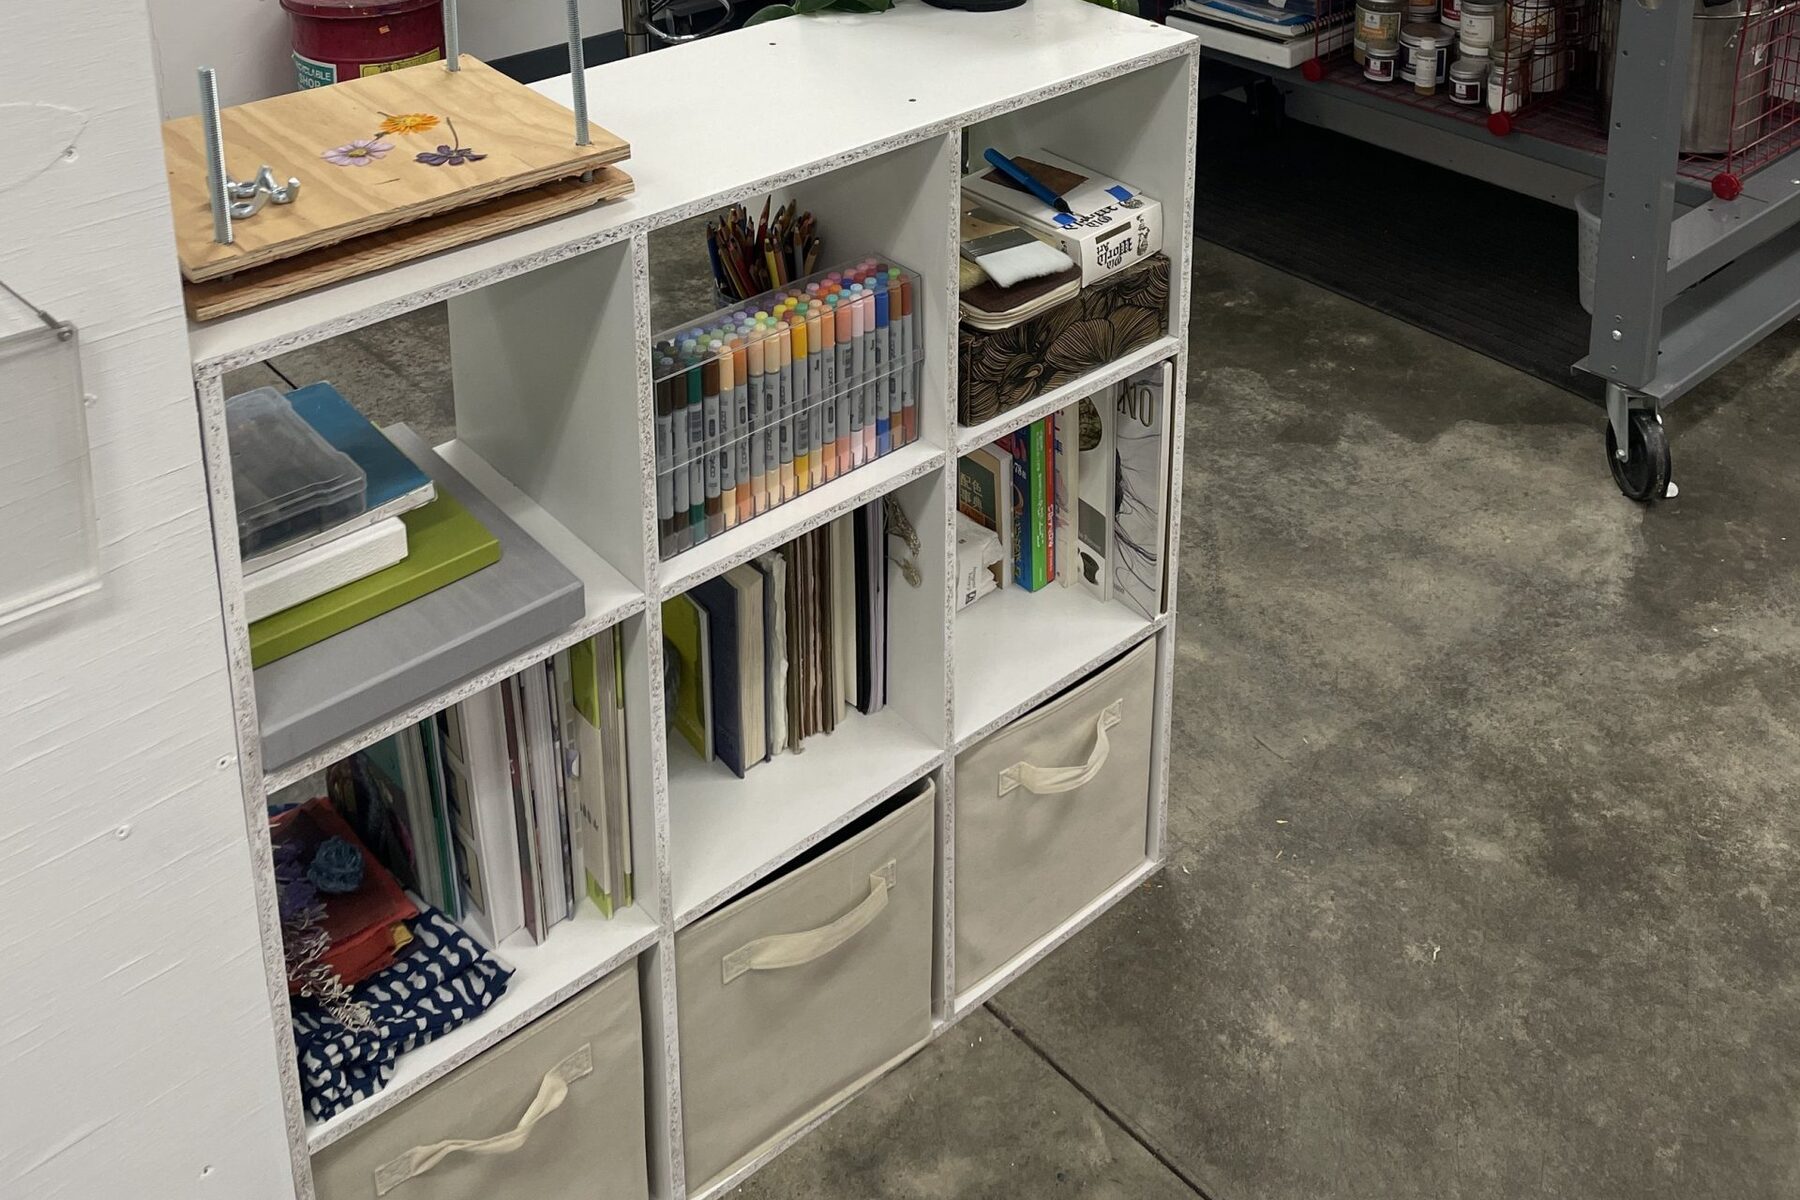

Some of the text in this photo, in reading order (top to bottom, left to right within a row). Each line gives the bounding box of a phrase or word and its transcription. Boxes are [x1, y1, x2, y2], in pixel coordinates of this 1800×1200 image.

[1096, 242, 1110, 255] Art
[1096, 237, 1133, 266] World
[1106, 256, 1122, 270] Old
